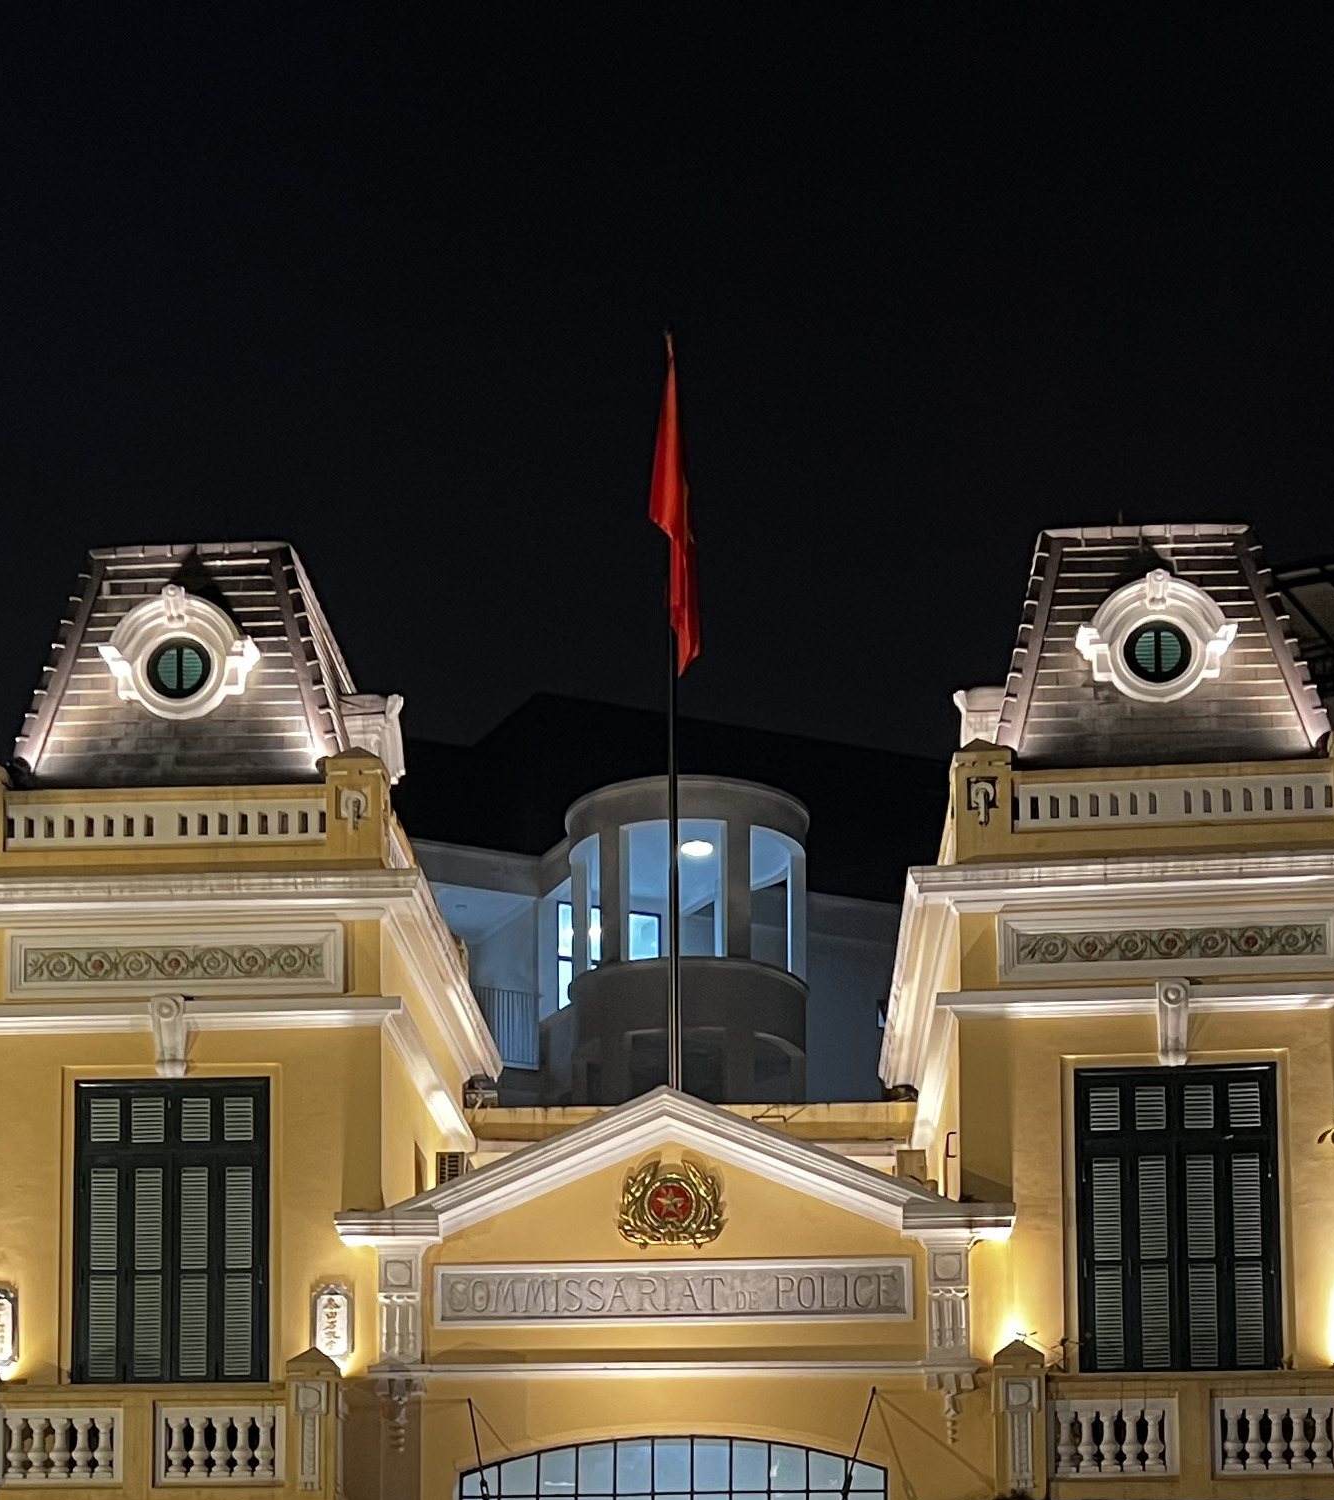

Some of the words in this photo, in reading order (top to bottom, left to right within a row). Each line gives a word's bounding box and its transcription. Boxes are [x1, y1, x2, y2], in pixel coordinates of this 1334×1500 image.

[447, 1274, 725, 1312] COMMISSARIAT
[735, 1290, 760, 1310] DE
[774, 1272, 902, 1310] POLICE
